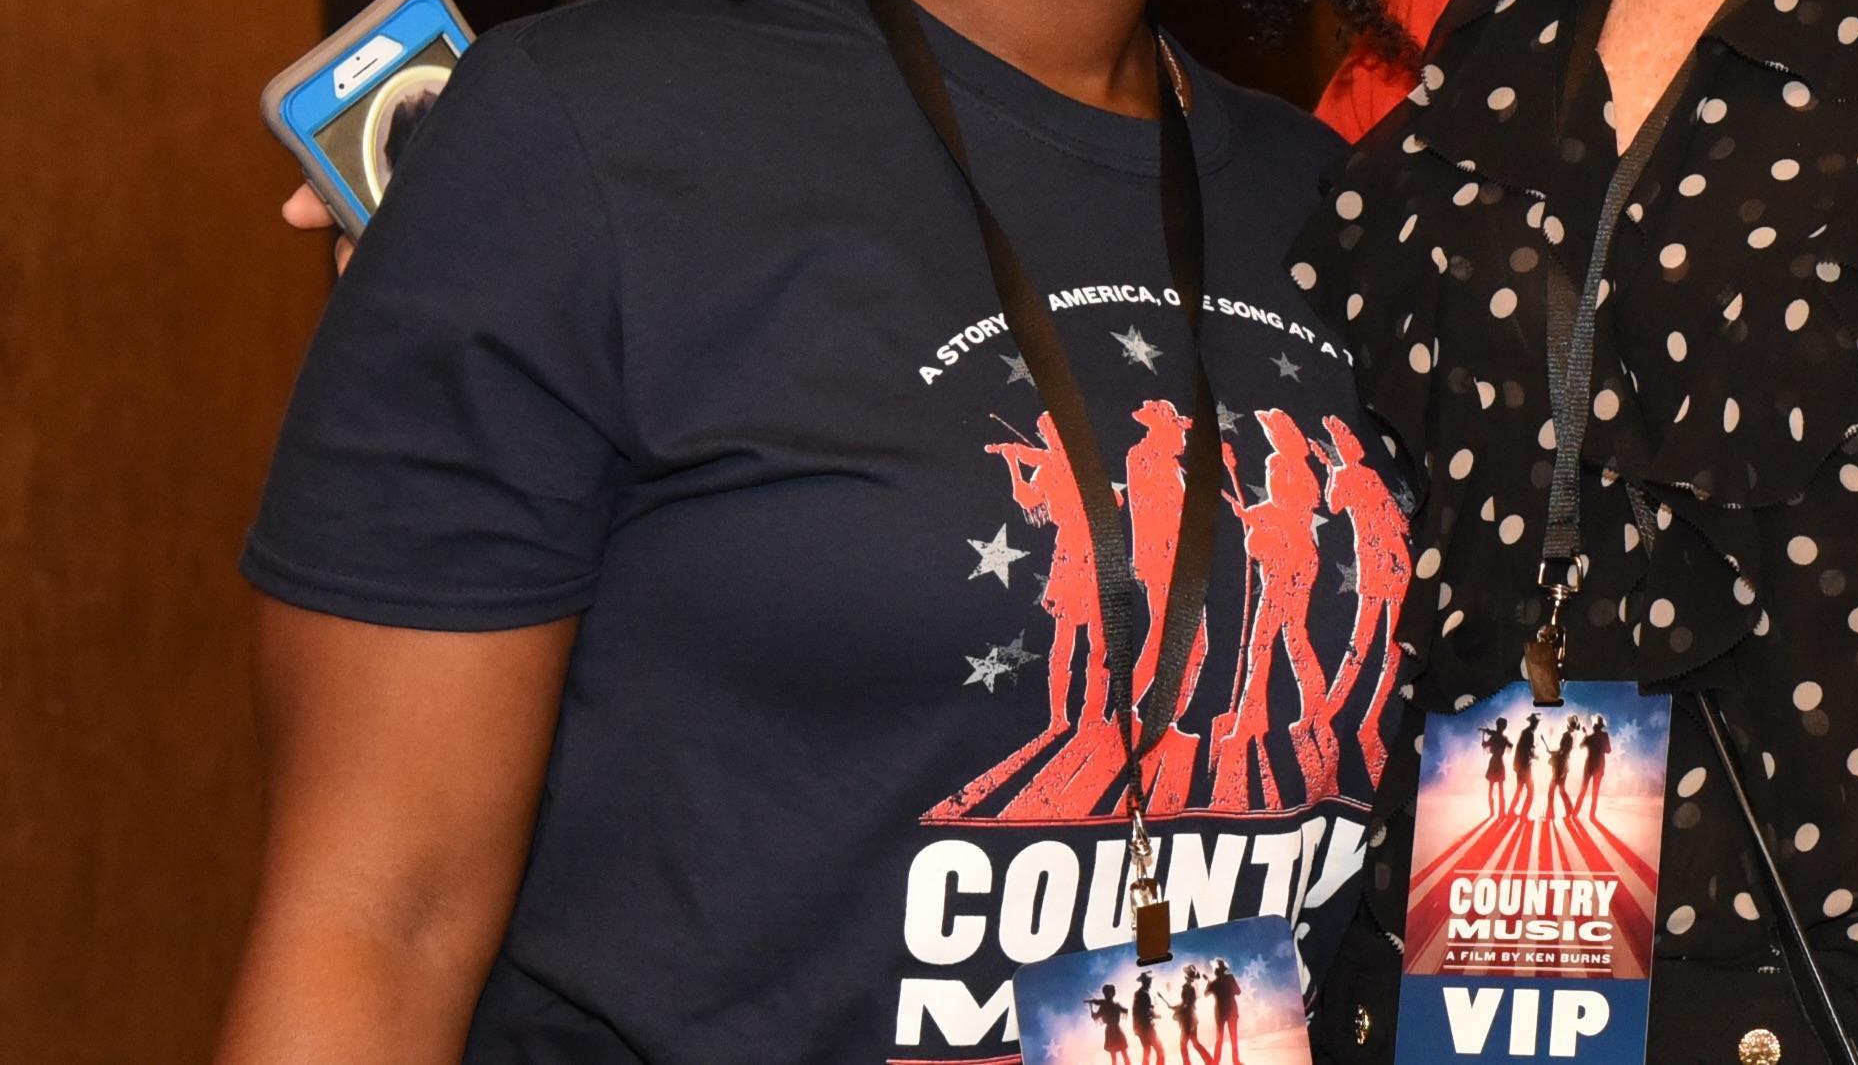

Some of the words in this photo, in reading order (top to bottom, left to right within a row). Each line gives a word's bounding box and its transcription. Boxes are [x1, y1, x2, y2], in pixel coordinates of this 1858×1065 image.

[918, 365, 944, 386] A
[935, 312, 1010, 367] STORY
[1047, 284, 1162, 312] AMERICA,
[1162, 287, 1216, 313] OE
[1216, 296, 1285, 331] SONG
[1288, 321, 1316, 344] AT
[1319, 341, 1338, 359] A
[1449, 877, 1619, 917] COUNTRY
[1447, 918, 1614, 942] MUSIC
[1445, 951, 1456, 961] A
[1460, 951, 1497, 962] FILM
[1501, 951, 1521, 962] BY
[1525, 952, 1555, 963] KEN
[1560, 953, 1612, 965] BURNS
[1442, 986, 1611, 1058] VIP
